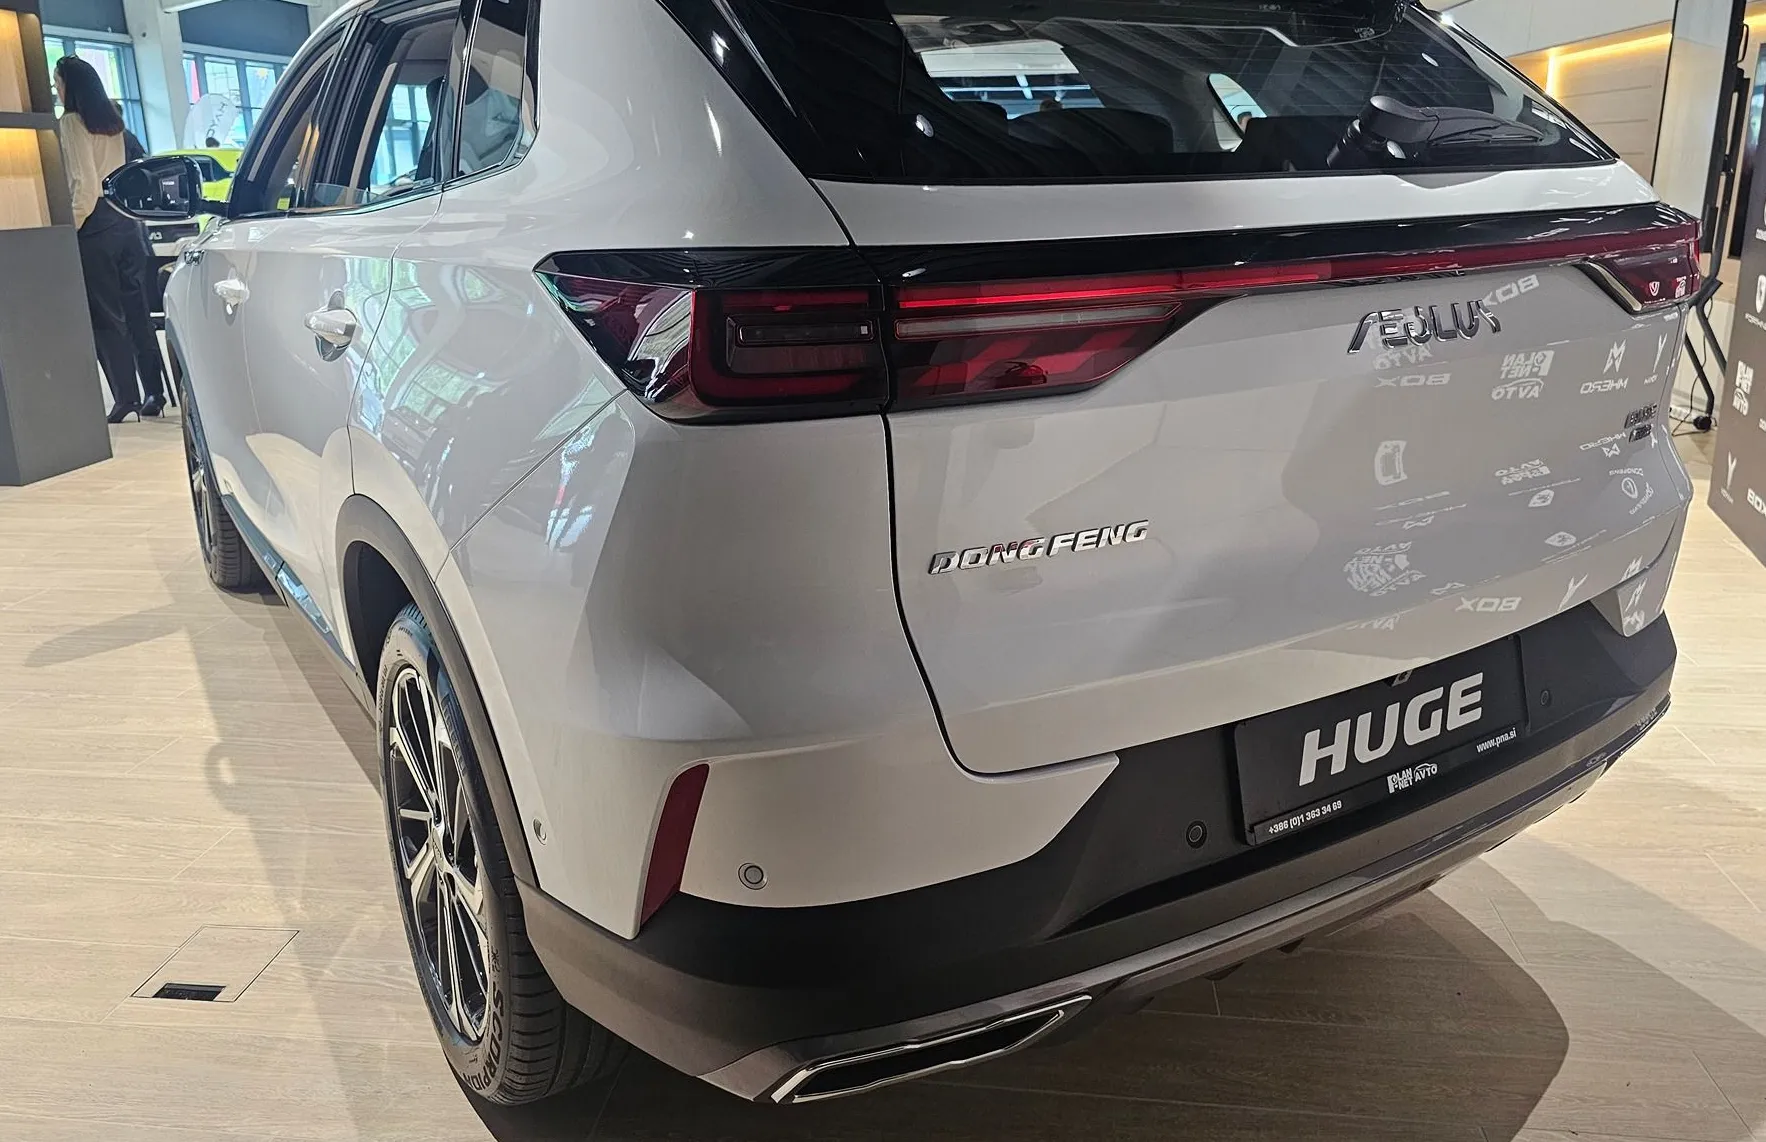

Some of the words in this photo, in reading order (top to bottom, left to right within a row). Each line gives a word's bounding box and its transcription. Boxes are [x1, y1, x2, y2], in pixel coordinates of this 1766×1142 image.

[928, 519, 1149, 575] DONGFENG
[1298, 672, 1483, 786] HUGE
[1477, 727, 1517, 752] www.pna.si
[1268, 820, 1289, 834] +386
[1306, 808, 1321, 821] 363
[1321, 804, 1332, 815] 34
[1332, 800, 1342, 811] 69
